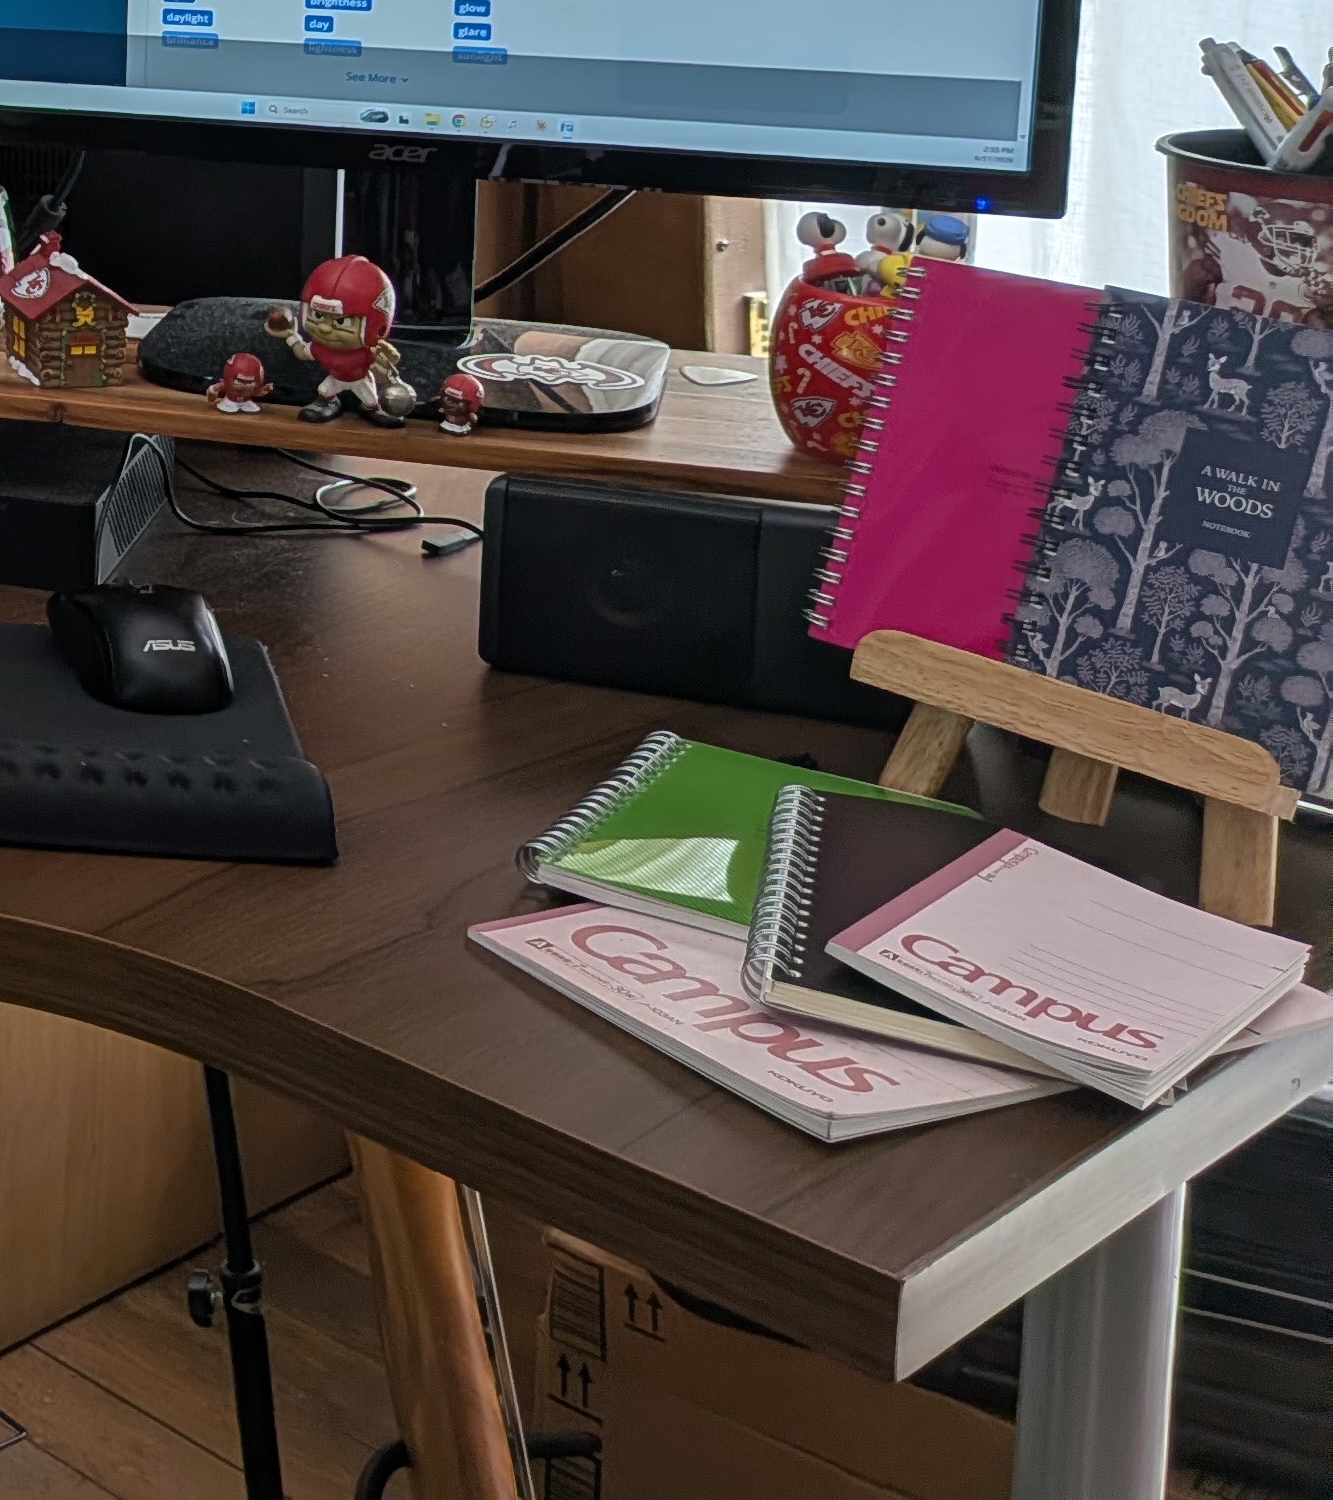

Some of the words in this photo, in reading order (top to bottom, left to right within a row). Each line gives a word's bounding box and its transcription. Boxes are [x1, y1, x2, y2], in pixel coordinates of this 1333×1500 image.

[167, 13, 209, 24] daylight
[368, 142, 437, 163] acer
[799, 344, 876, 398] CHIEFS
[1201, 465, 1211, 477] A
[1215, 468, 1259, 487] WALK
[1262, 479, 1281, 492] IN
[1227, 484, 1247, 495] THE
[1195, 487, 1274, 519] WOODS
[1202, 521, 1251, 538] NOTEBOOK
[142, 639, 196, 655] ASUS
[900, 932, 1166, 1053] Campus
[570, 924, 901, 1094] Campus
[1077, 1037, 1149, 1061] KOKUYO
[767, 1069, 835, 1104] KOKUYO
